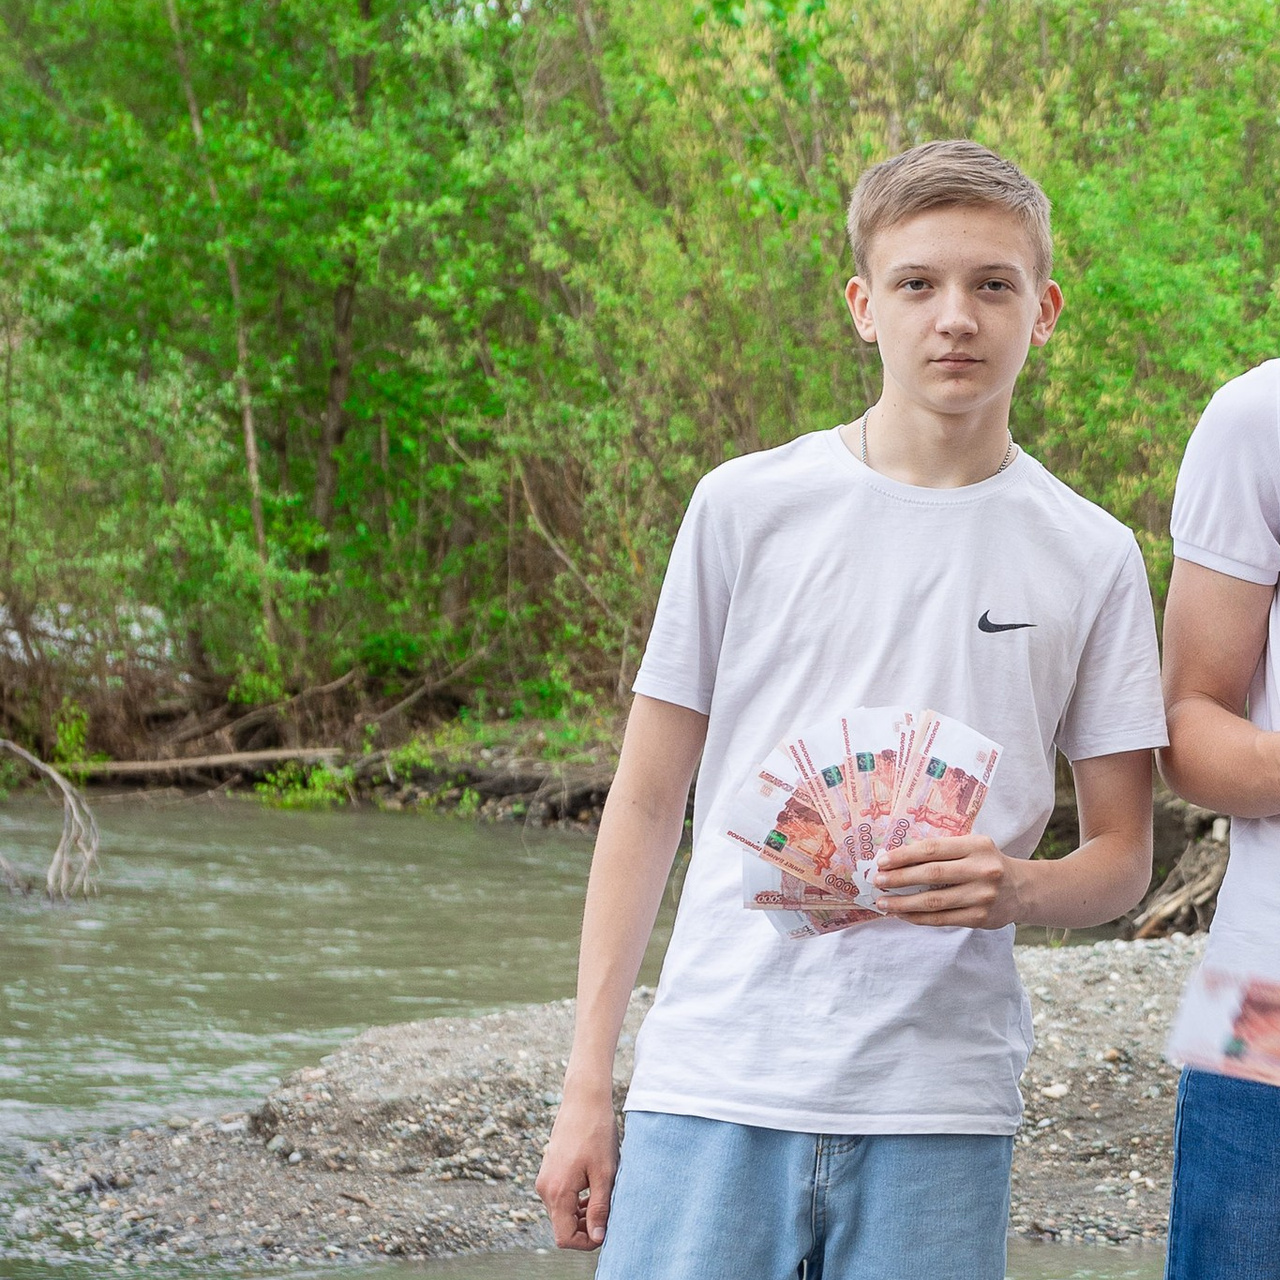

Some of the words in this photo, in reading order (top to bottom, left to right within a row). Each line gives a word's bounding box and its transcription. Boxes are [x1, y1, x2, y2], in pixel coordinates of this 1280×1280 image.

[924, 720, 941, 756] ПРИКОЛОВ
[798, 739, 816, 775] ПРИКОЛОВ
[726, 830, 763, 852] ПРИКОЛОВ
[858, 823, 875, 861] 5000
[756, 894, 783, 905] 5000
